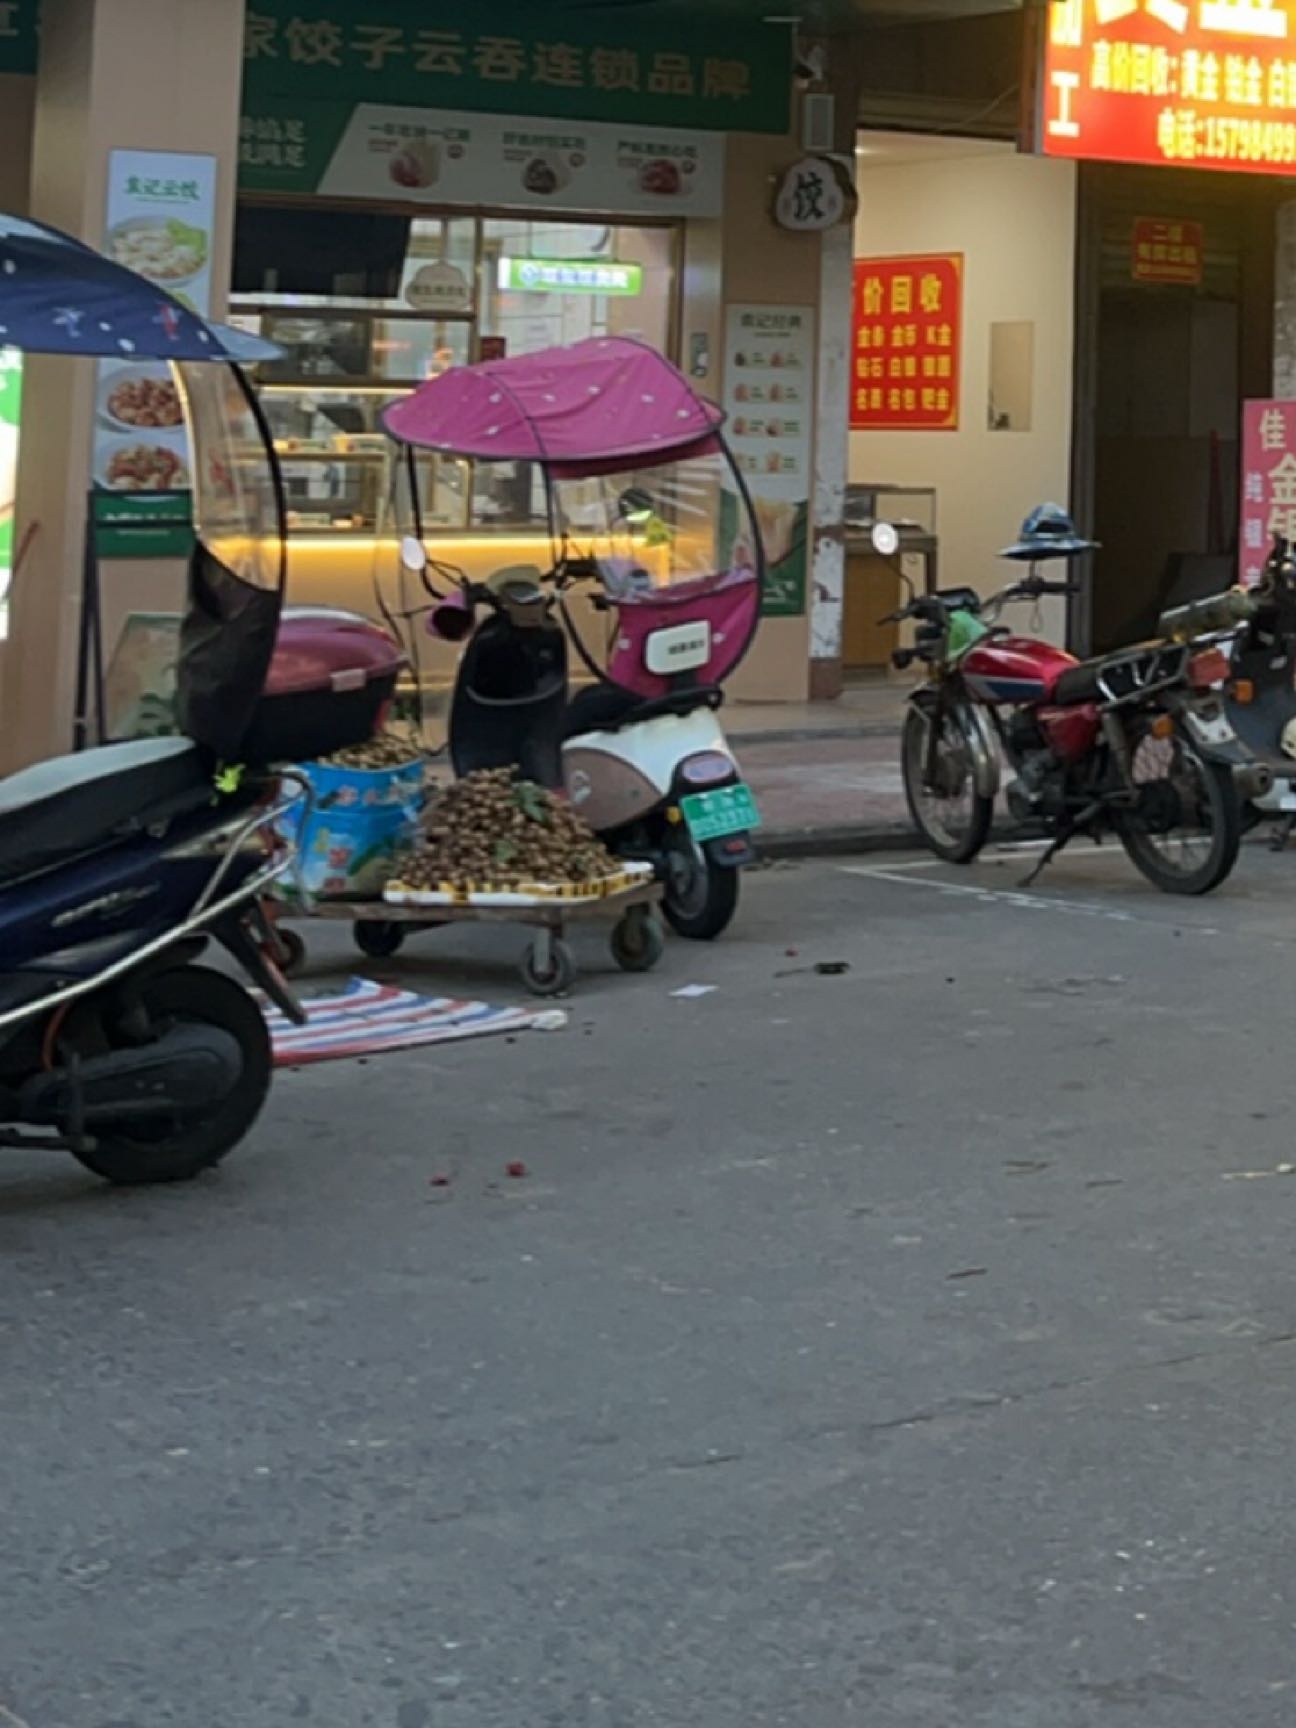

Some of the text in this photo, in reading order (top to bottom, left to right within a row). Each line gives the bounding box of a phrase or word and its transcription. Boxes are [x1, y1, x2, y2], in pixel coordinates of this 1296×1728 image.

[793, 171, 824, 220] 饺
[852, 273, 942, 316] 价回收
